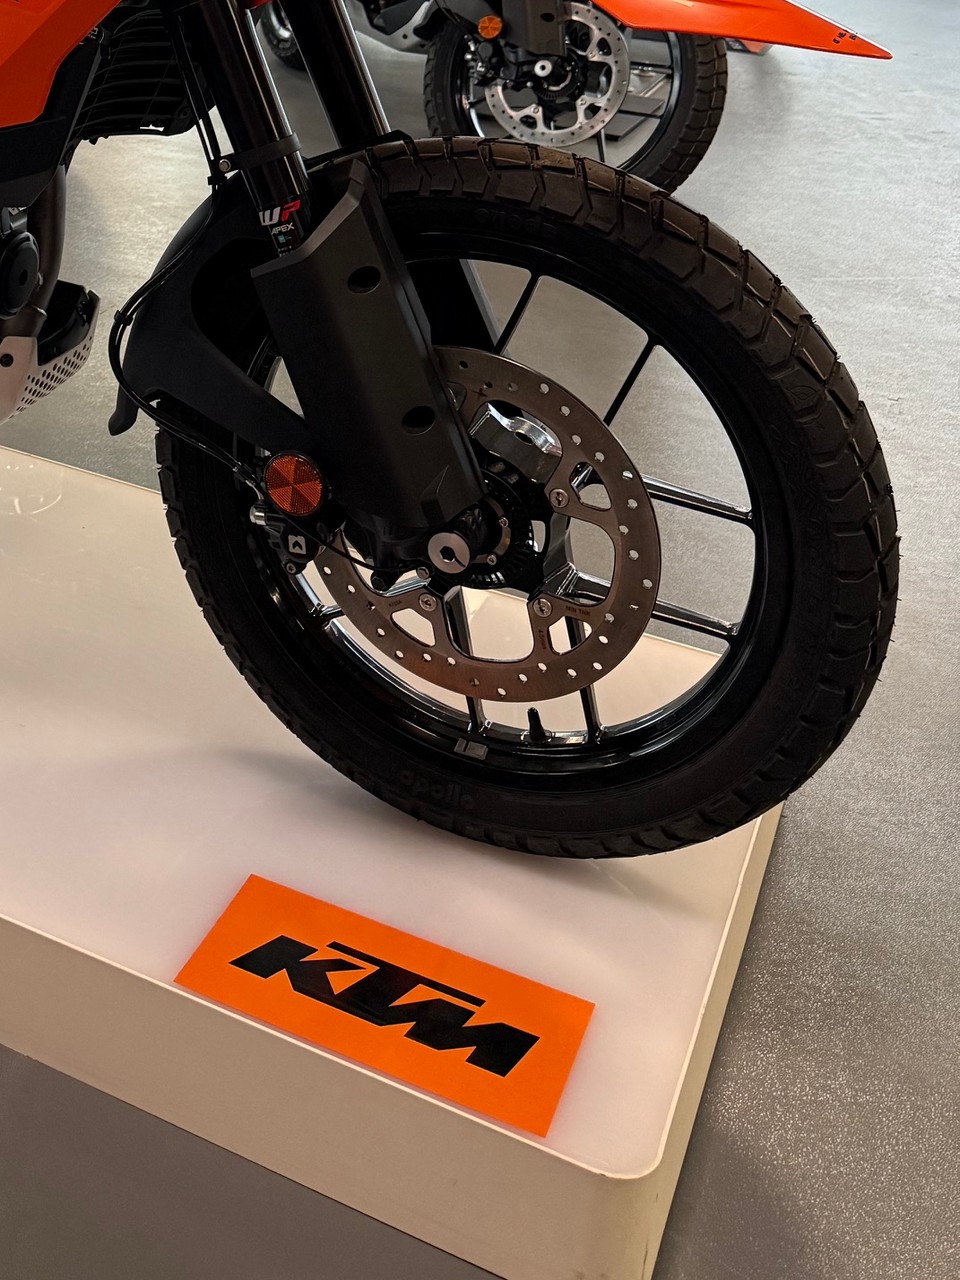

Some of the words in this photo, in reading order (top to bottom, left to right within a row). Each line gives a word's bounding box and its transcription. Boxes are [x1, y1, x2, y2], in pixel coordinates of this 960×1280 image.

[258, 200, 300, 226] WP
[271, 222, 295, 234] APEX
[228, 934, 540, 1078] KTM
